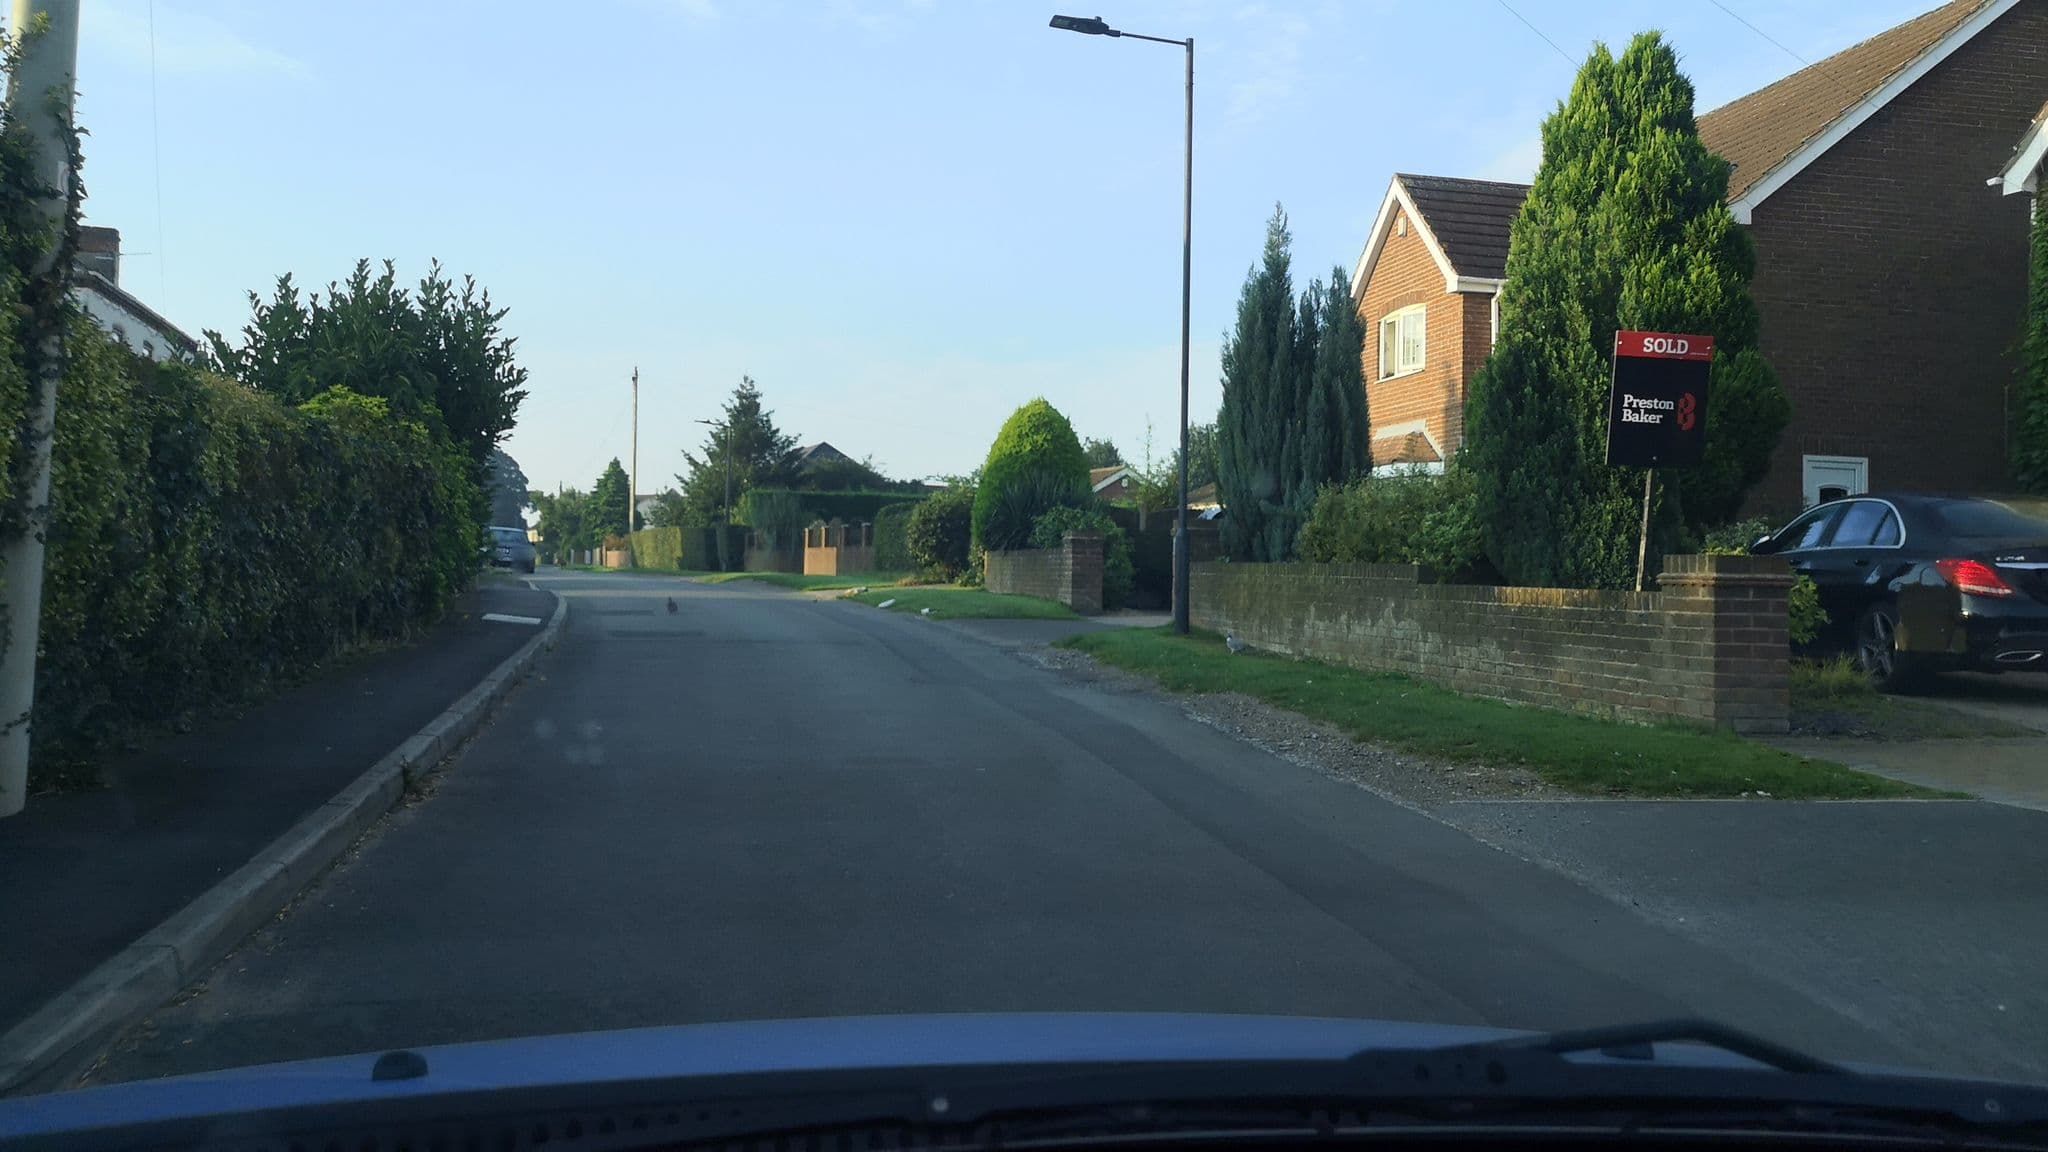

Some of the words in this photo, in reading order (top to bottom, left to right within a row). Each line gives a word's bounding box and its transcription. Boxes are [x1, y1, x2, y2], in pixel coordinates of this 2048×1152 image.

[1643, 337, 1688, 354] SOLD
[1622, 394, 1674, 410] Preston
[1621, 408, 1663, 424] Baker
